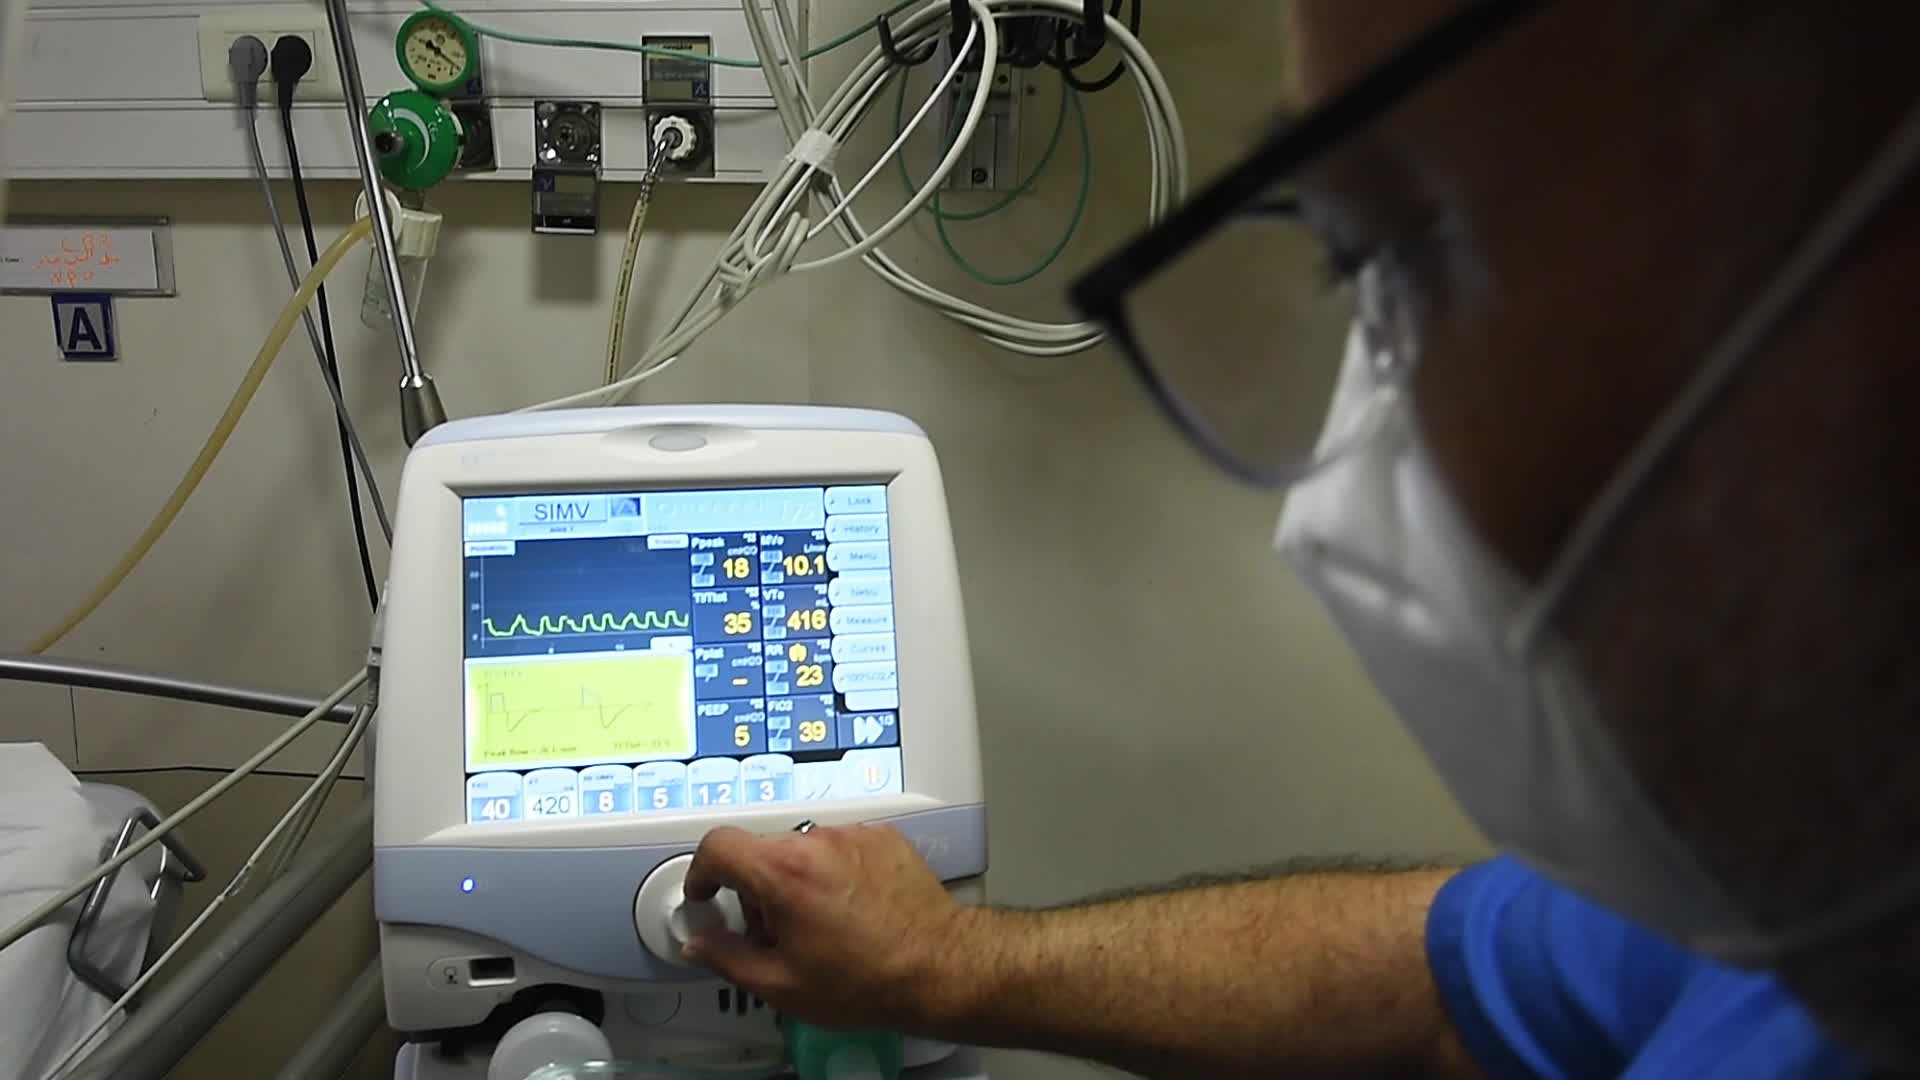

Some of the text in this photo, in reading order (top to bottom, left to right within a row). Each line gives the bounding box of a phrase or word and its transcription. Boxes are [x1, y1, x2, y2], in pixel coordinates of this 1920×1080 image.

[68, 307, 102, 349] A
[534, 501, 590, 521] SIMV
[723, 557, 750, 579] 18
[783, 555, 825, 576] 10.1
[724, 612, 752, 635] 35
[787, 609, 827, 630] 416
[796, 665, 824, 688] 23
[734, 725, 751, 747] 5
[799, 721, 826, 743] 39
[598, 791, 614, 812] 8
[652, 787, 668, 809] 5
[696, 783, 733, 806] 1.2
[759, 780, 775, 801] 3
[481, 798, 511, 820] 40
[532, 795, 571, 816] 420
